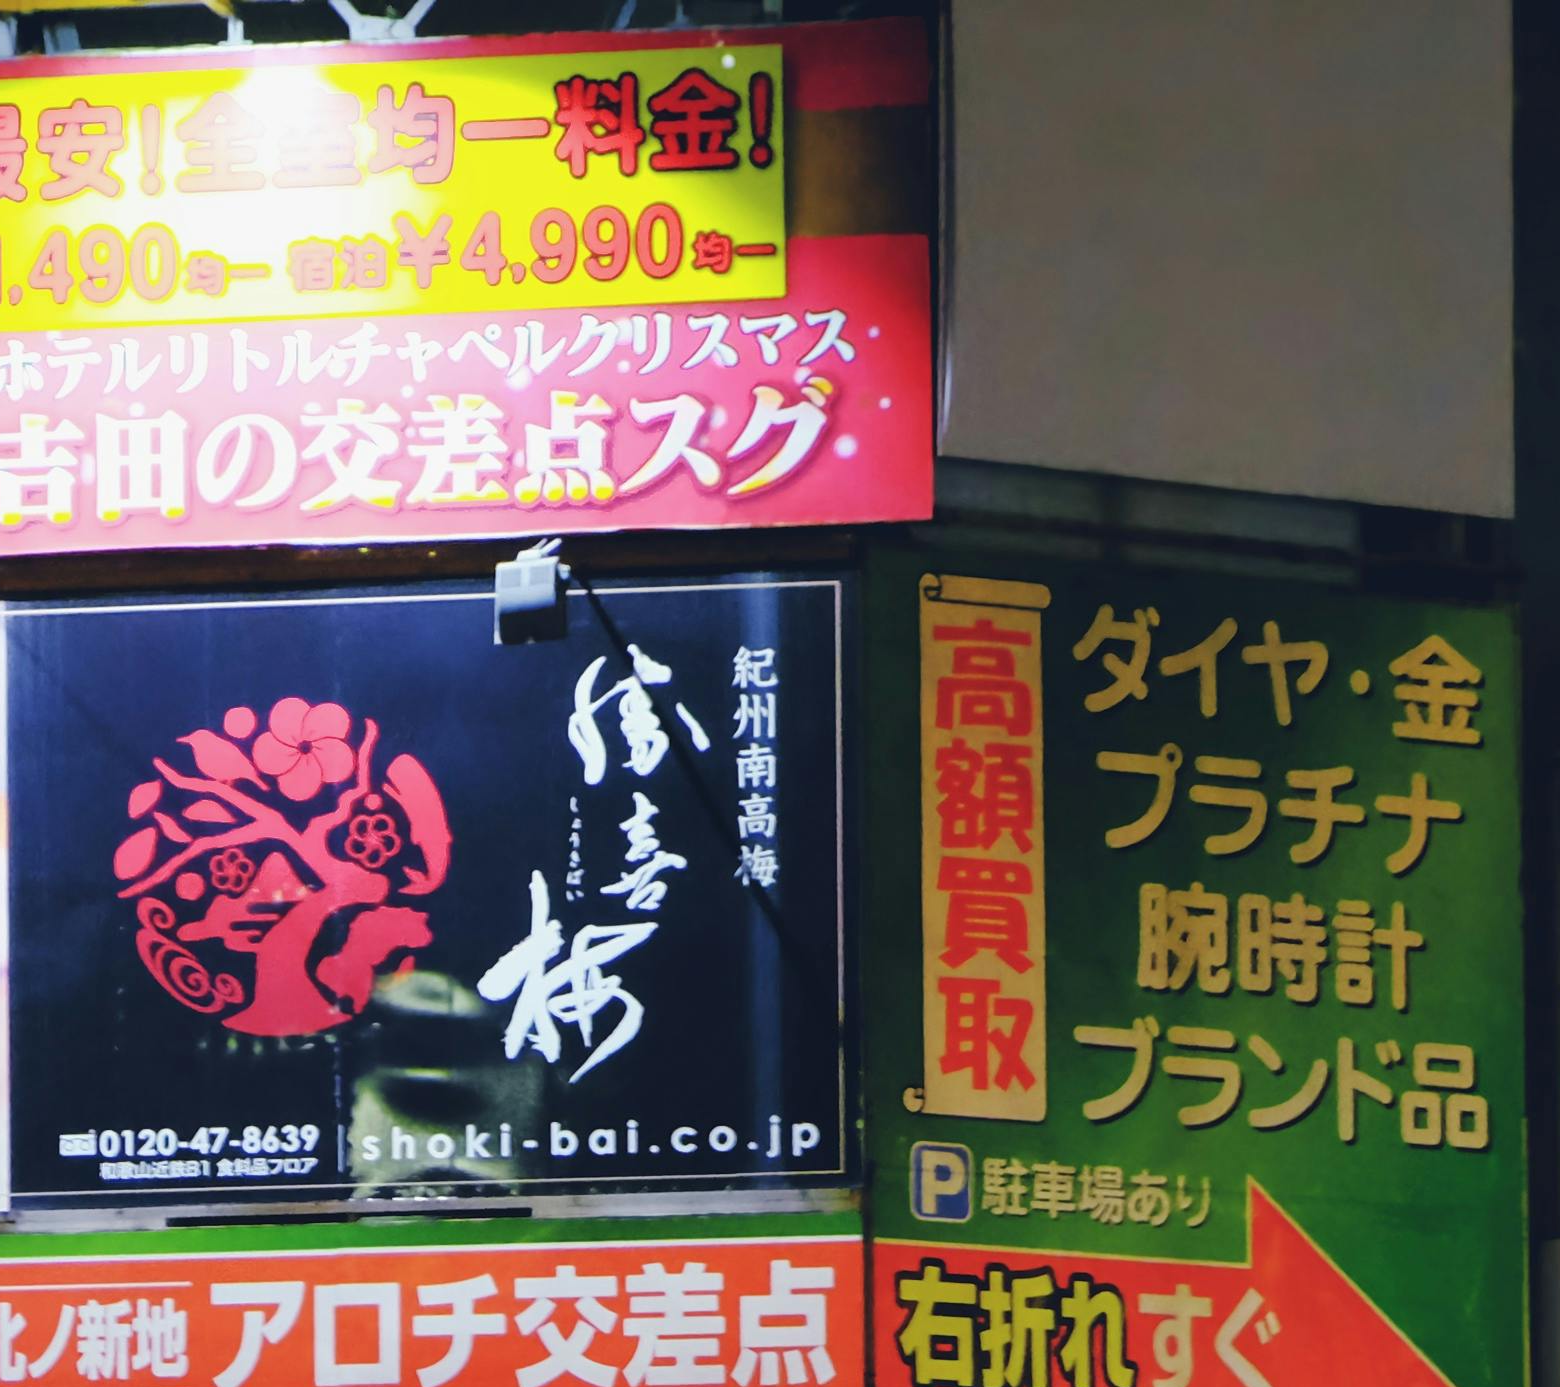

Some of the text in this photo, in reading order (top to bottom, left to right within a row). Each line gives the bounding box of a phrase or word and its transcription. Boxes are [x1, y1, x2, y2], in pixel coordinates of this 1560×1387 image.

[1072, 604, 1483, 746] ダイヤ・金
[730, 645, 780, 887] 紀州南高梅
[1095, 742, 1463, 875] プラチナ
[932, 618, 1036, 1094] 高額買取
[1136, 882, 1425, 1012] 腕時計
[97, 1124, 321, 1158] 0120-47-8639
[360, 1115, 822, 1163] shoki-bai.co.jp
[1072, 1014, 1490, 1150] ブランド品
[980, 1157, 1212, 1229] 駐車場あり
